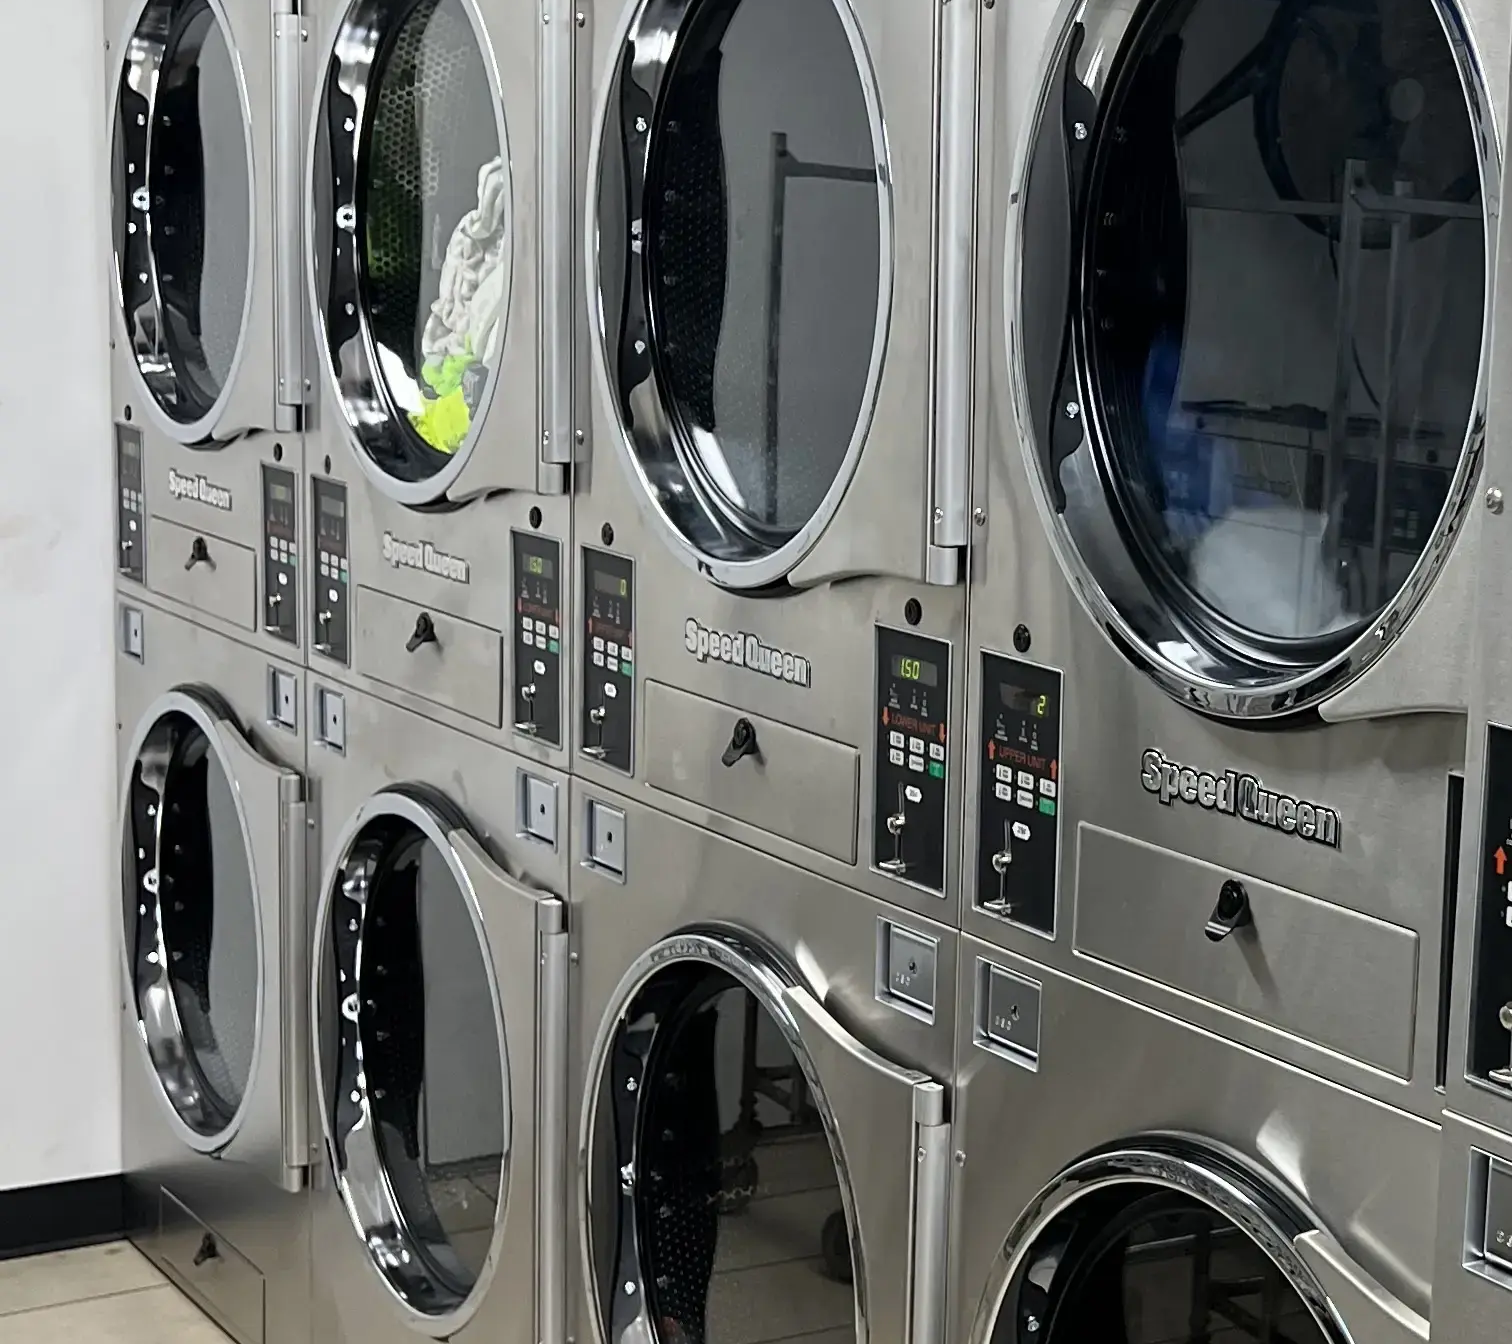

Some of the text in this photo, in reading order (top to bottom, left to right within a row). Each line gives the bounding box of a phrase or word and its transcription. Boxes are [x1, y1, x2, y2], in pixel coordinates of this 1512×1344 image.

[169, 467, 232, 511] Speed Queen
[383, 530, 470, 584] Speed Queen
[685, 617, 811, 688] Speed Queen
[1141, 748, 1341, 850] Speed Queen
